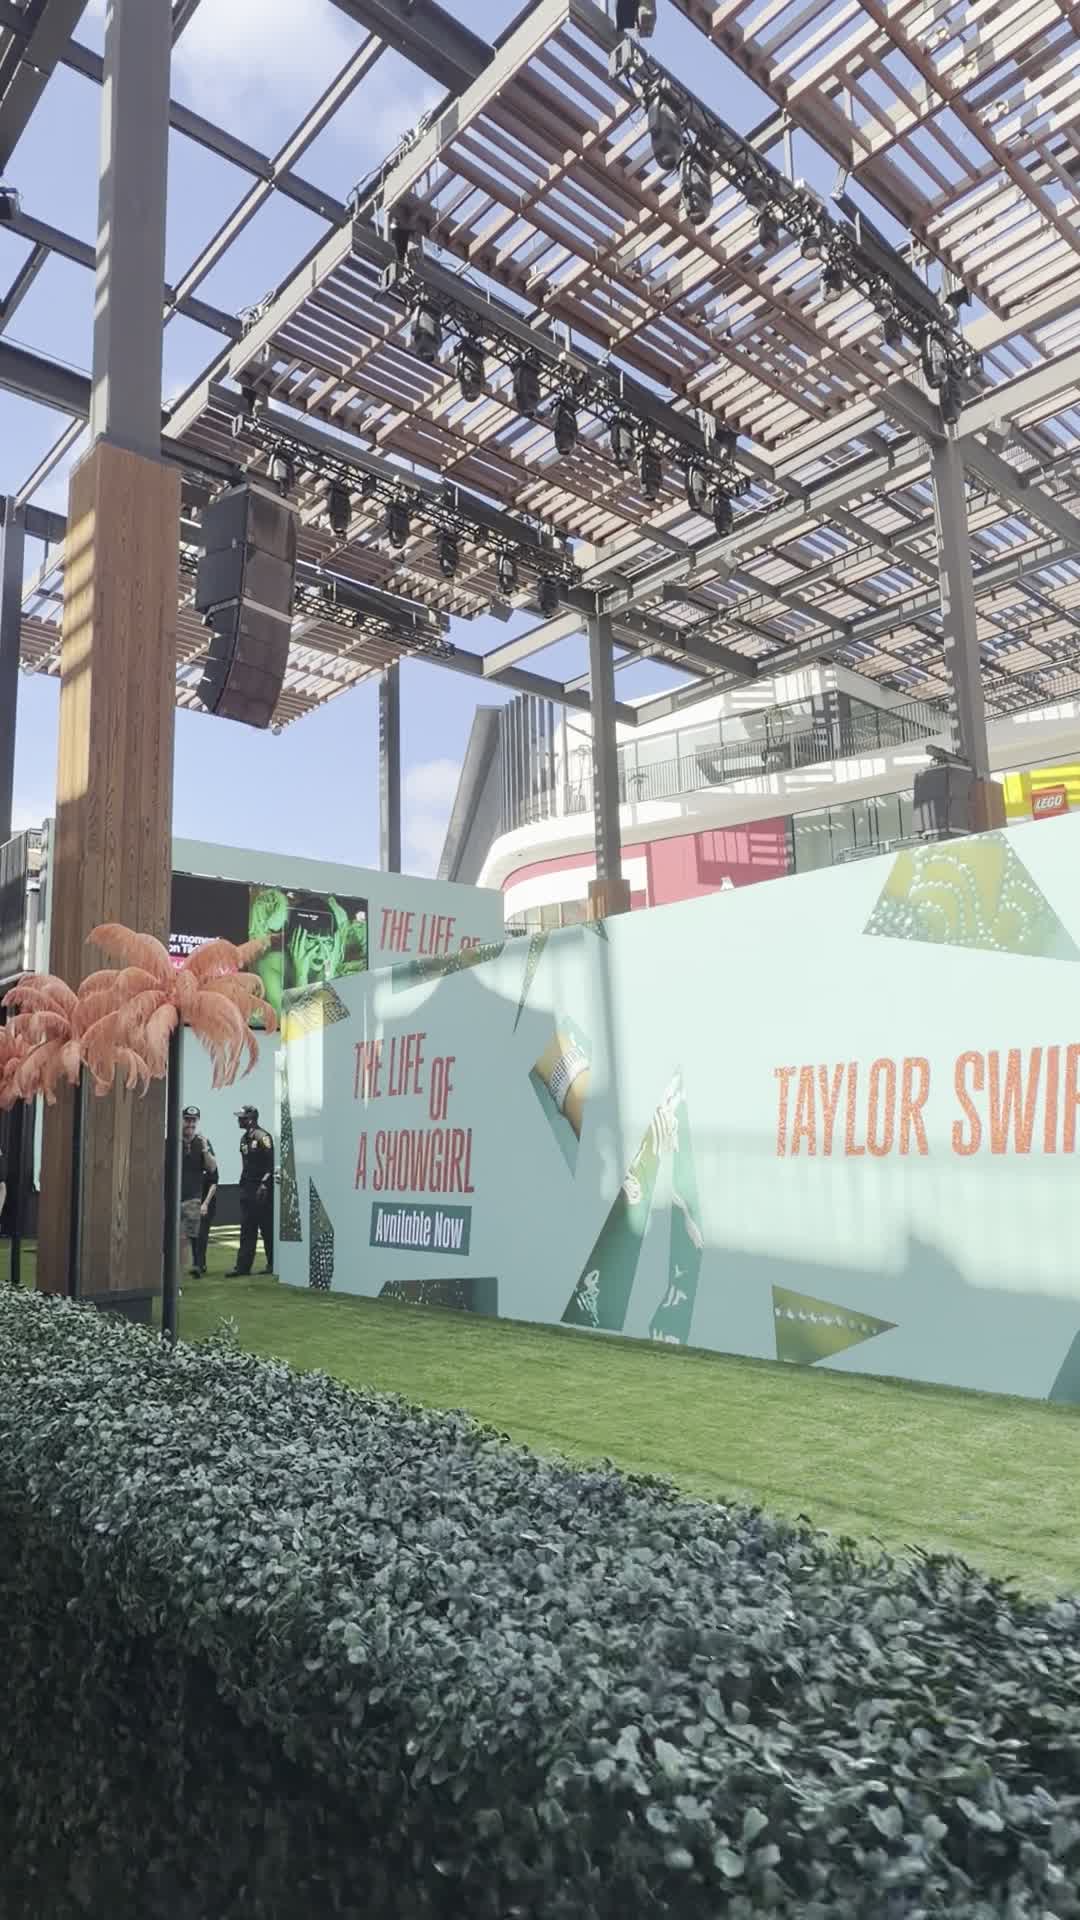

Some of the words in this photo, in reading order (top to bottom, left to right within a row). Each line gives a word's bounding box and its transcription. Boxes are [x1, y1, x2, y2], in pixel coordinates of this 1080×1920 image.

[1034, 794, 1063, 809] LEGO
[380, 907, 415, 953] THE
[354, 1039, 384, 1099] THE
[388, 1032, 427, 1096] LIFE
[430, 1056, 456, 1120] OF
[774, 1056, 931, 1156] TAYLOR
[355, 1131, 367, 1190] A
[373, 1127, 474, 1193] SHOWGIRL
[375, 1208, 431, 1247] Available
[433, 1211, 464, 1249] Now
